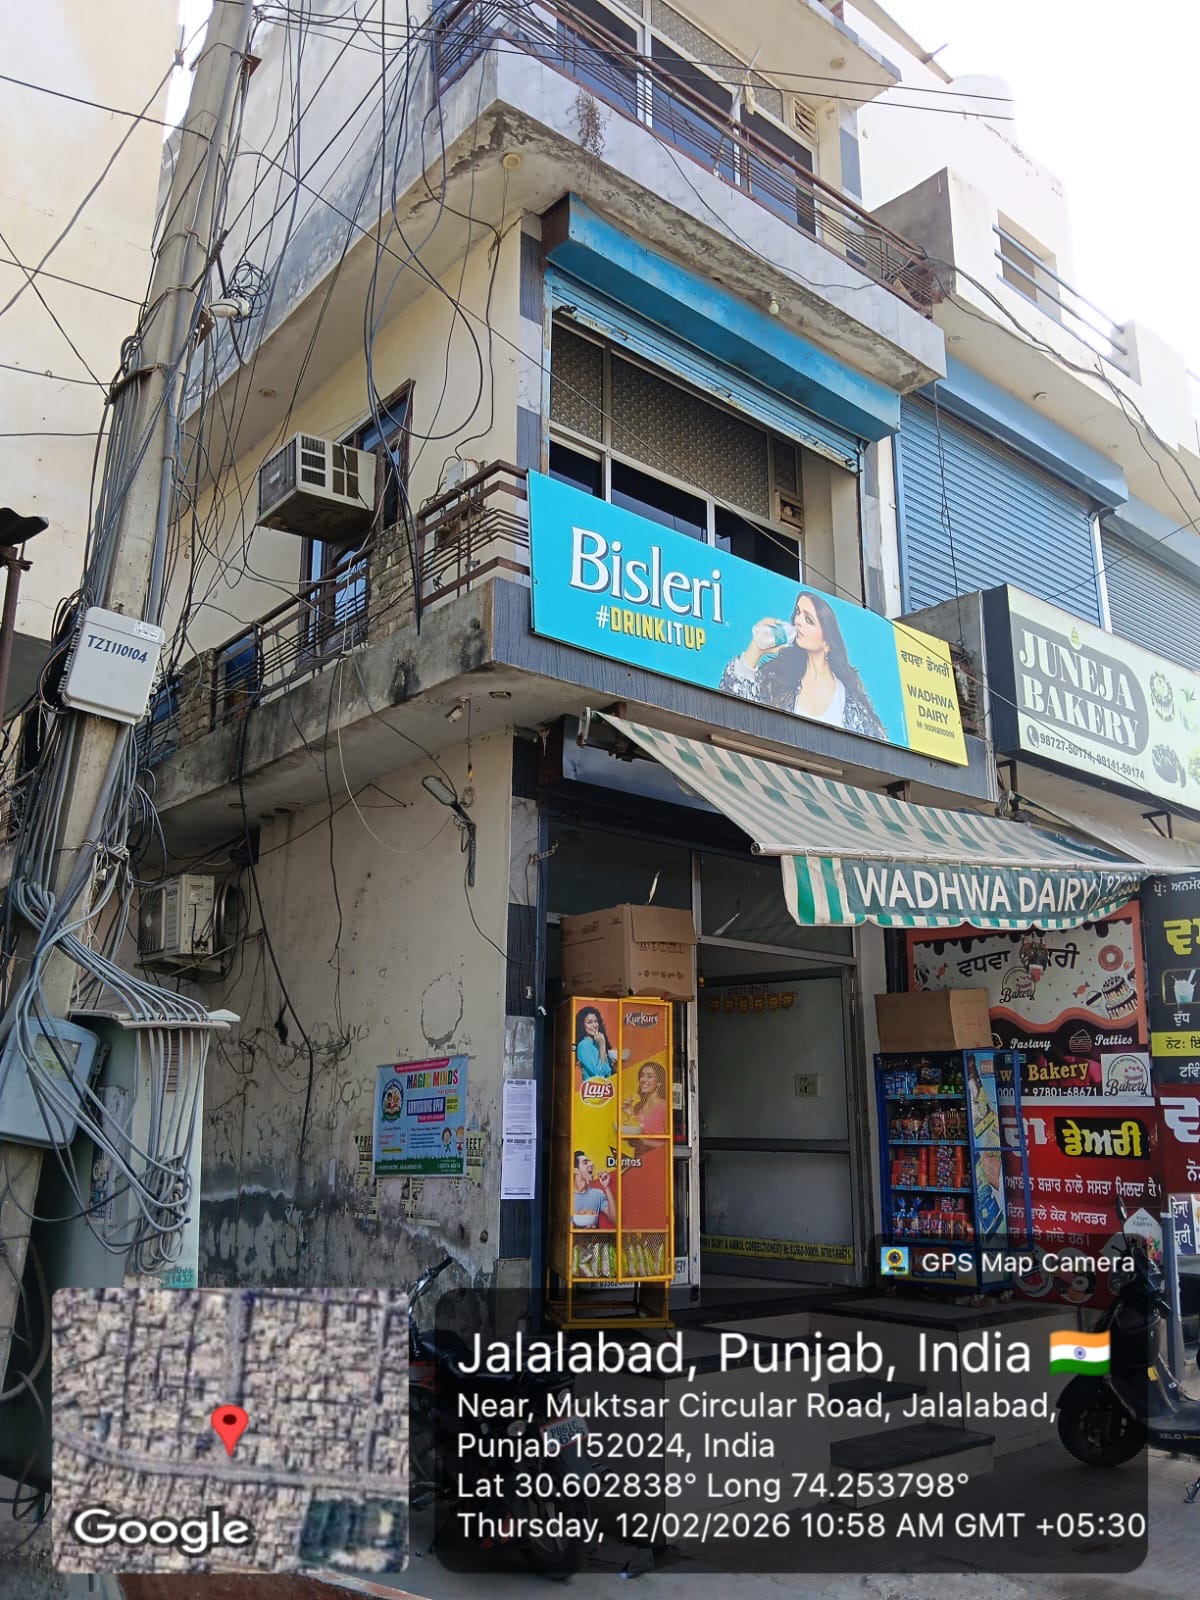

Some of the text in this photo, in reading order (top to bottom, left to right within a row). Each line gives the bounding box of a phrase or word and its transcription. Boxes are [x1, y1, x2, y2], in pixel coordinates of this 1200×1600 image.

[569, 526, 724, 624] Bisleri
[596, 604, 706, 651] #DRINKITUP
[1019, 628, 1136, 712] JUNEJA
[907, 684, 955, 711] WADHWA
[917, 704, 949, 725] DAIRY
[1021, 673, 1140, 750] BAKERY
[853, 866, 1011, 912] WADHWA
[1018, 876, 1098, 913] DAIRY
[957, 950, 1011, 976] ਵਧਵਾ
[999, 988, 1035, 1003] Bakery
[1094, 1033, 1133, 1046] Patties
[406, 1072, 431, 1089] MAGIC
[432, 1069, 458, 1087] MINDS
[1027, 1062, 1089, 1081] Bakery
[1104, 1078, 1148, 1096] Bakery
[1062, 1119, 1142, 1157] ਡੇਅਰੀ
[1050, 1205, 1067, 1222] ਕੇਕ
[1070, 1211, 1107, 1226] ਆਰਡਰ
